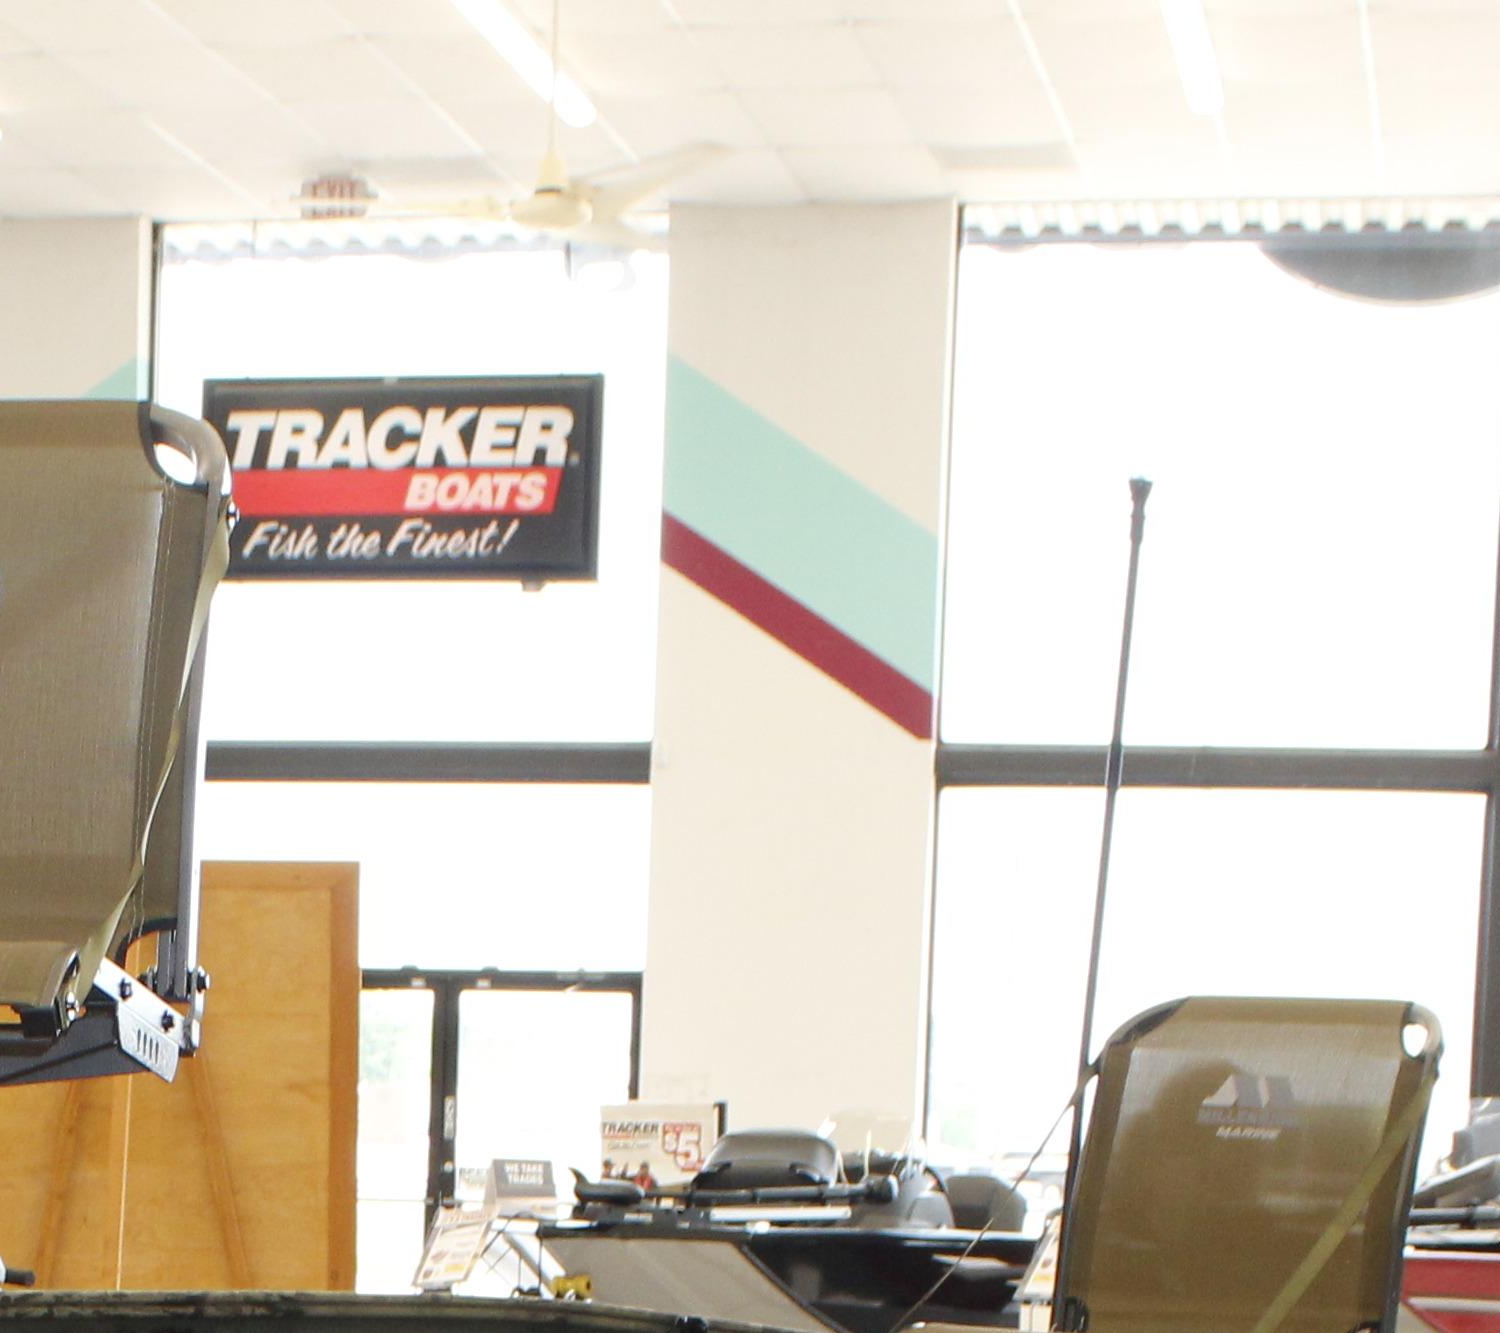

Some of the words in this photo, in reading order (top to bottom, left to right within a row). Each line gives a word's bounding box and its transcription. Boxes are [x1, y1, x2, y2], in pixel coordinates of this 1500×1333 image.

[226, 404, 575, 470] TRACKER
[403, 471, 548, 511] BOATS
[242, 520, 319, 561] Fish
[325, 521, 381, 561] the
[386, 517, 520, 561] Finest!
[602, 1122, 660, 1135] TRACKER
